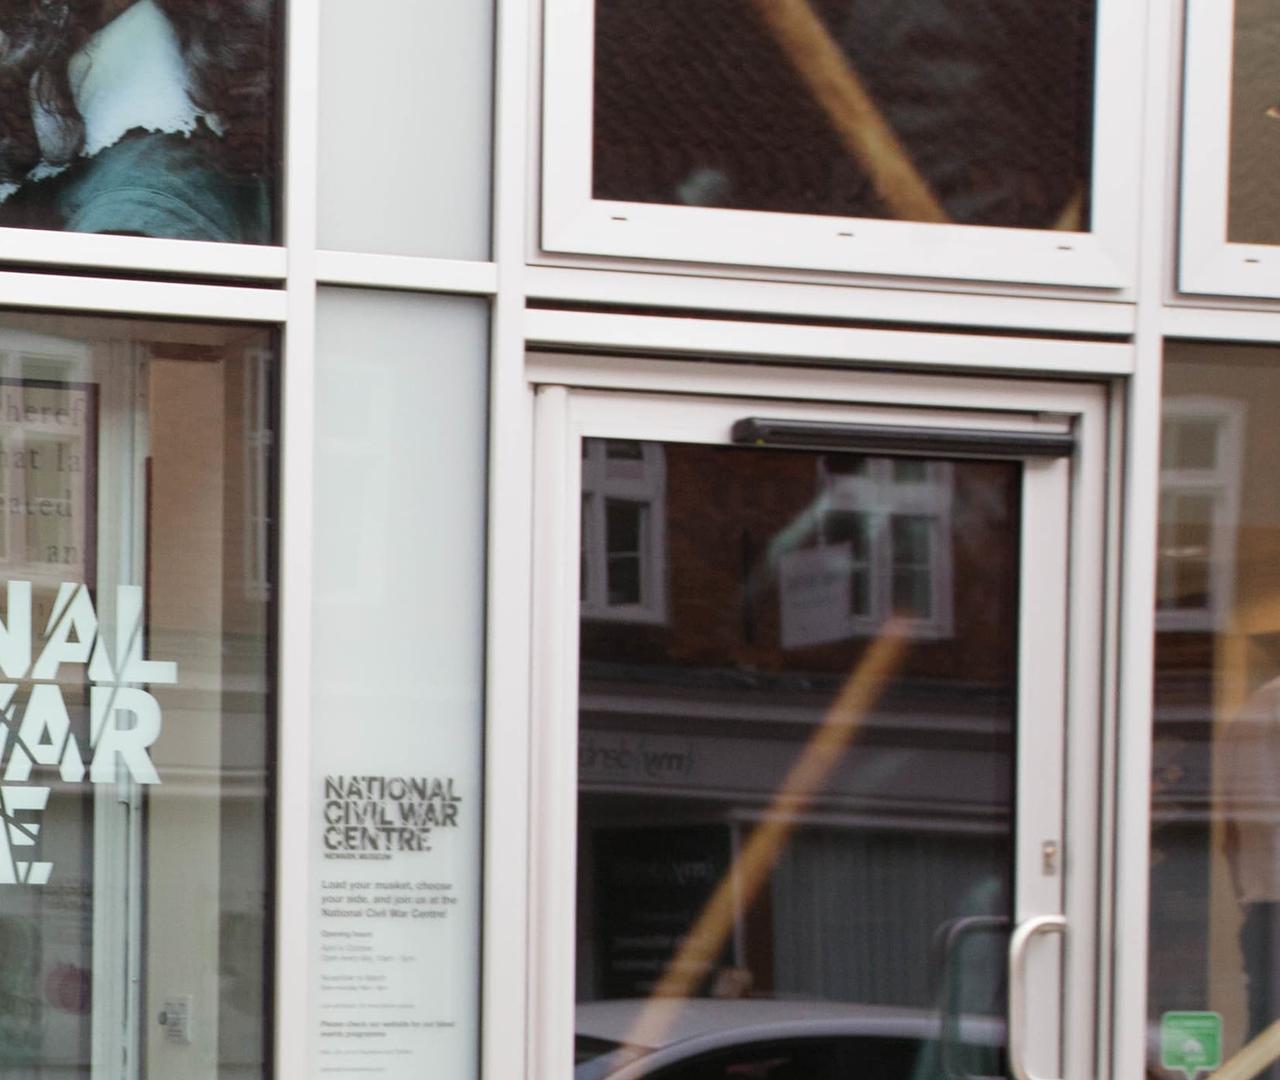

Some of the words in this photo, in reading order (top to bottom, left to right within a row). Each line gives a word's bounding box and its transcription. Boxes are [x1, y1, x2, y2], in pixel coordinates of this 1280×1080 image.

[323, 774, 463, 802] NATIONAL
[323, 800, 394, 827] CIVIL
[399, 801, 459, 828] WAR
[323, 826, 433, 852] CENTRE
[349, 881, 371, 891] your
[321, 895, 343, 905] your
[373, 895, 391, 904] and
[441, 895, 458, 905] the
[321, 907, 362, 918] National
